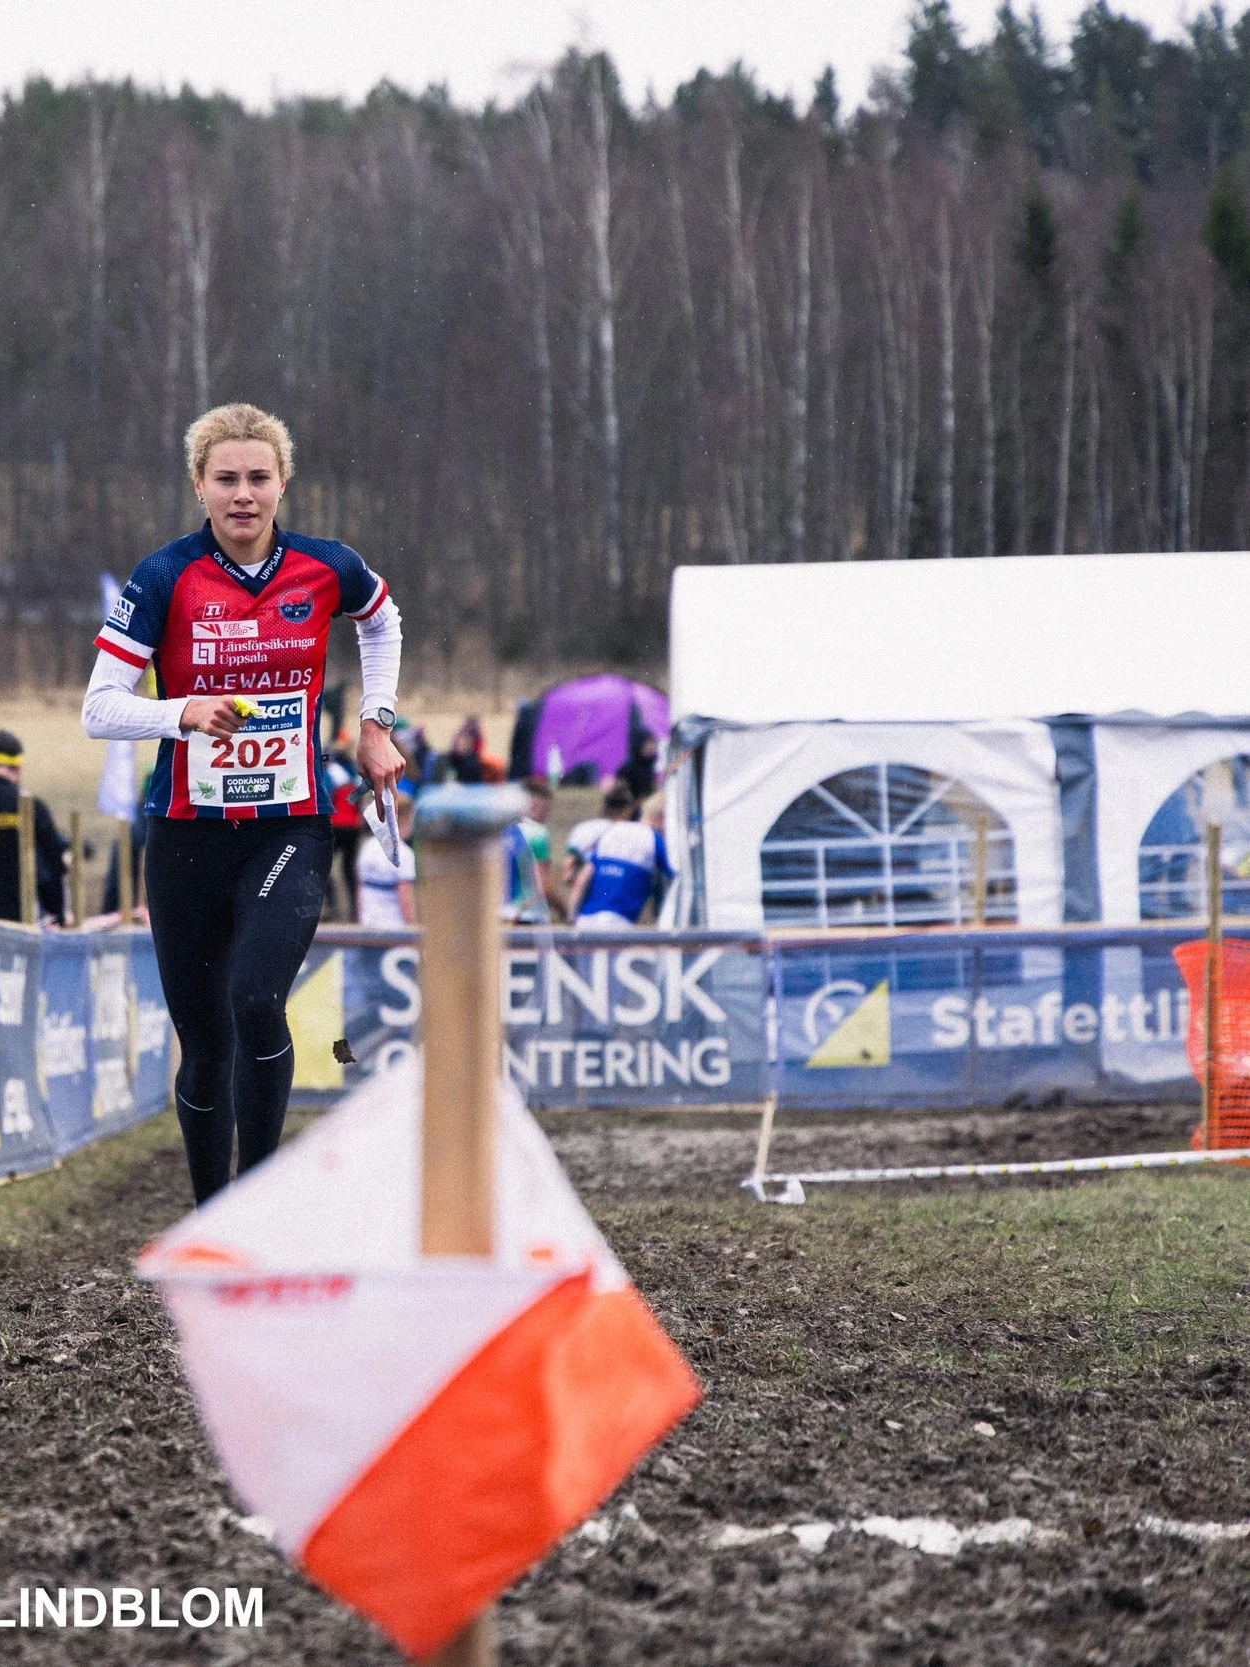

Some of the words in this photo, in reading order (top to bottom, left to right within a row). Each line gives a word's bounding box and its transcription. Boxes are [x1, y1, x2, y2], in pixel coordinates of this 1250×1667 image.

[213, 551, 224, 565] OK
[224, 562, 246, 581] Linné
[260, 546, 284, 580] UPPSALA
[219, 637, 317, 653] Länsförsäkringar
[219, 652, 268, 666] Uppsala
[193, 668, 313, 691] ALEWALDS
[210, 737, 287, 769] 202
[226, 784, 270, 794] AVLOPP
[227, 777, 271, 786] GODKÄNDA
[257, 844, 297, 898] noname
[379, 946, 727, 1027] SENSK
